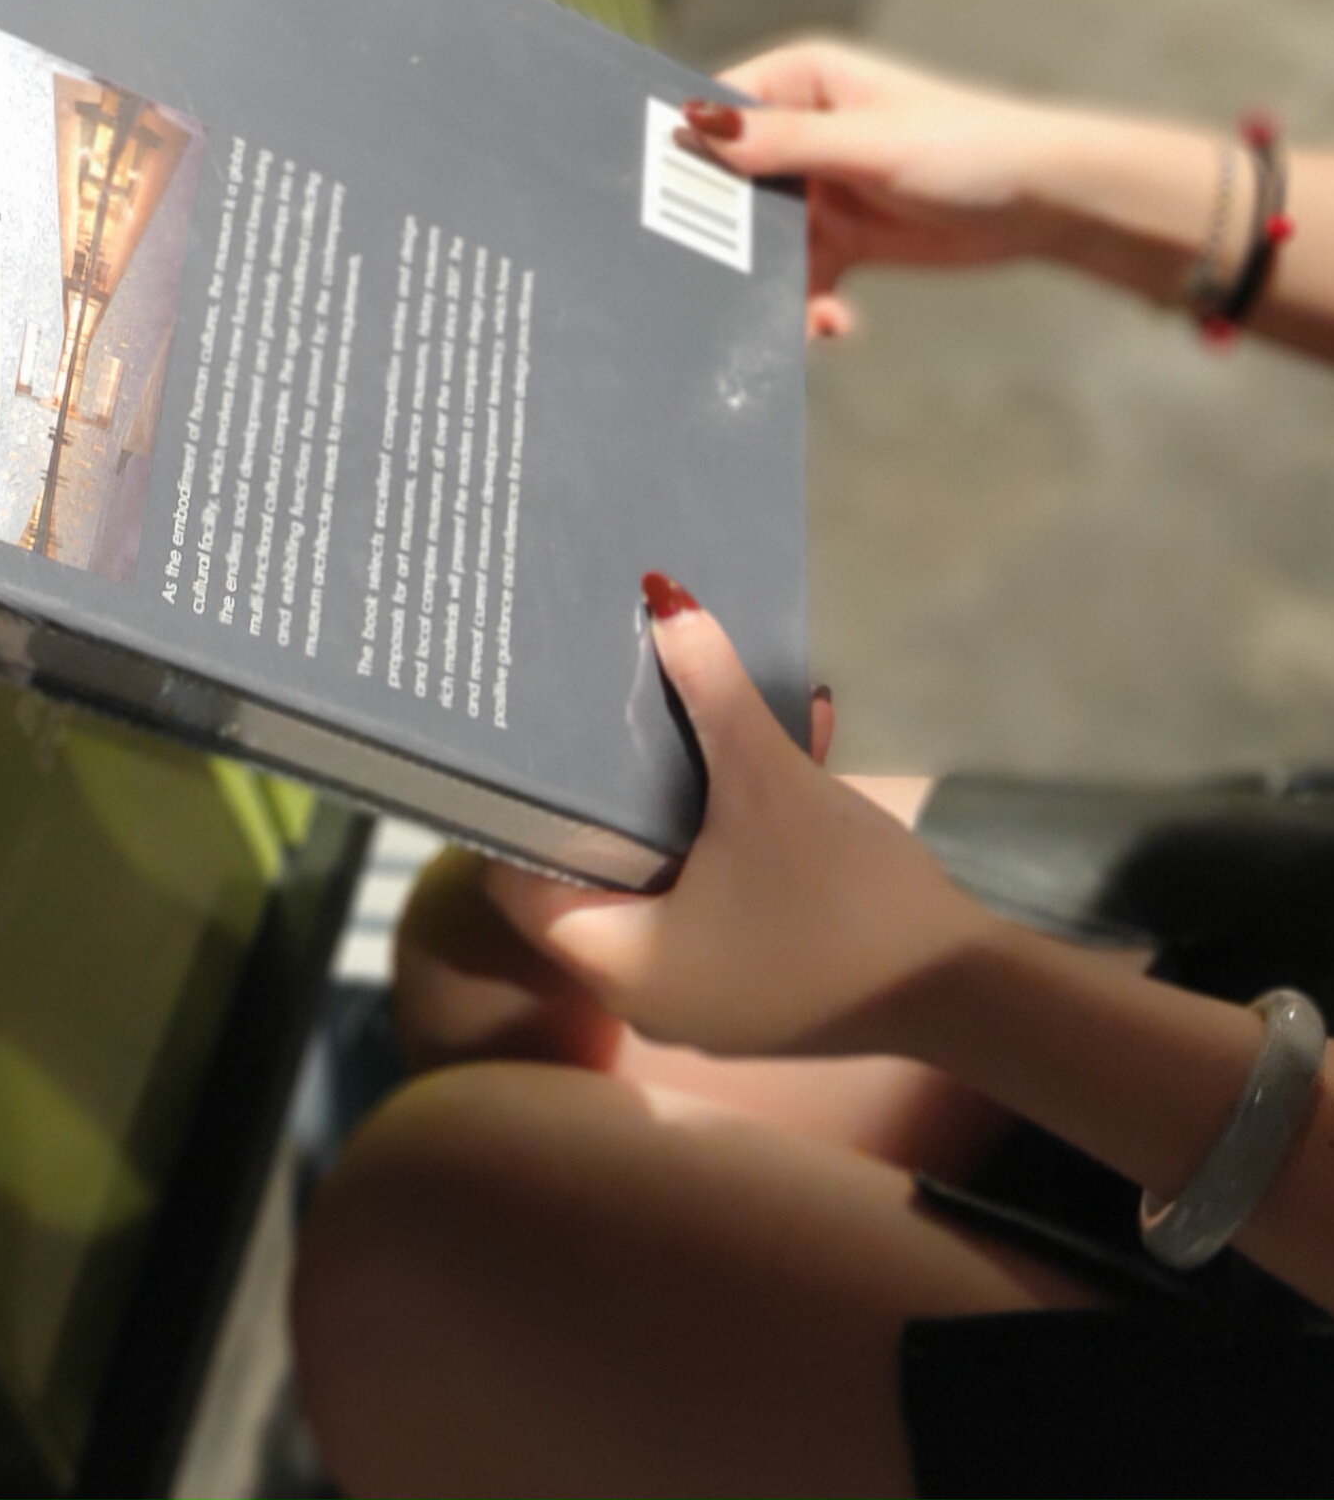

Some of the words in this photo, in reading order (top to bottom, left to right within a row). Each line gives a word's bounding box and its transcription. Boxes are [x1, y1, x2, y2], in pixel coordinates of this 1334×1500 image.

[208, 273, 223, 297] the
[229, 327, 242, 359] new
[255, 339, 268, 372] and
[189, 366, 208, 419] human
[223, 360, 238, 388] into
[186, 421, 199, 440] of
[216, 391, 233, 446] evolves
[239, 375, 263, 477] development
[300, 409, 315, 437] has
[327, 425, 340, 441] to
[209, 449, 224, 493] which
[289, 442, 311, 516] functions
[324, 444, 338, 489] needs
[172, 443, 196, 545] embodiment
[234, 484, 249, 527] social
[249, 513, 273, 635] multi-functional
[264, 454, 281, 512] cultural
[278, 357, 294, 383] The
[375, 452, 390, 527] excellent
[313, 492, 332, 585] architecture
[165, 549, 181, 577] the
[192, 552, 210, 613] cultural
[225, 532, 242, 591] endless
[282, 521, 304, 603] exhibiting
[367, 533, 384, 589] selects
[396, 553, 408, 577] art
[422, 545, 436, 613] complex
[502, 554, 514, 587] and
[162, 581, 177, 603] As
[392, 581, 406, 603] for
[448, 573, 460, 598] will
[474, 571, 486, 626] current
[219, 595, 234, 623] the
[277, 608, 291, 645] and
[305, 588, 321, 656] museum
[361, 595, 377, 639] book
[497, 589, 512, 664] guidance
[388, 608, 404, 687] proposals
[416, 616, 431, 658] local
[444, 603, 459, 672] materials
[470, 628, 483, 679] reveal
[357, 645, 373, 675] The
[414, 660, 428, 697] and
[439, 676, 453, 707] rich
[467, 681, 480, 717] and
[493, 666, 507, 728] positive
